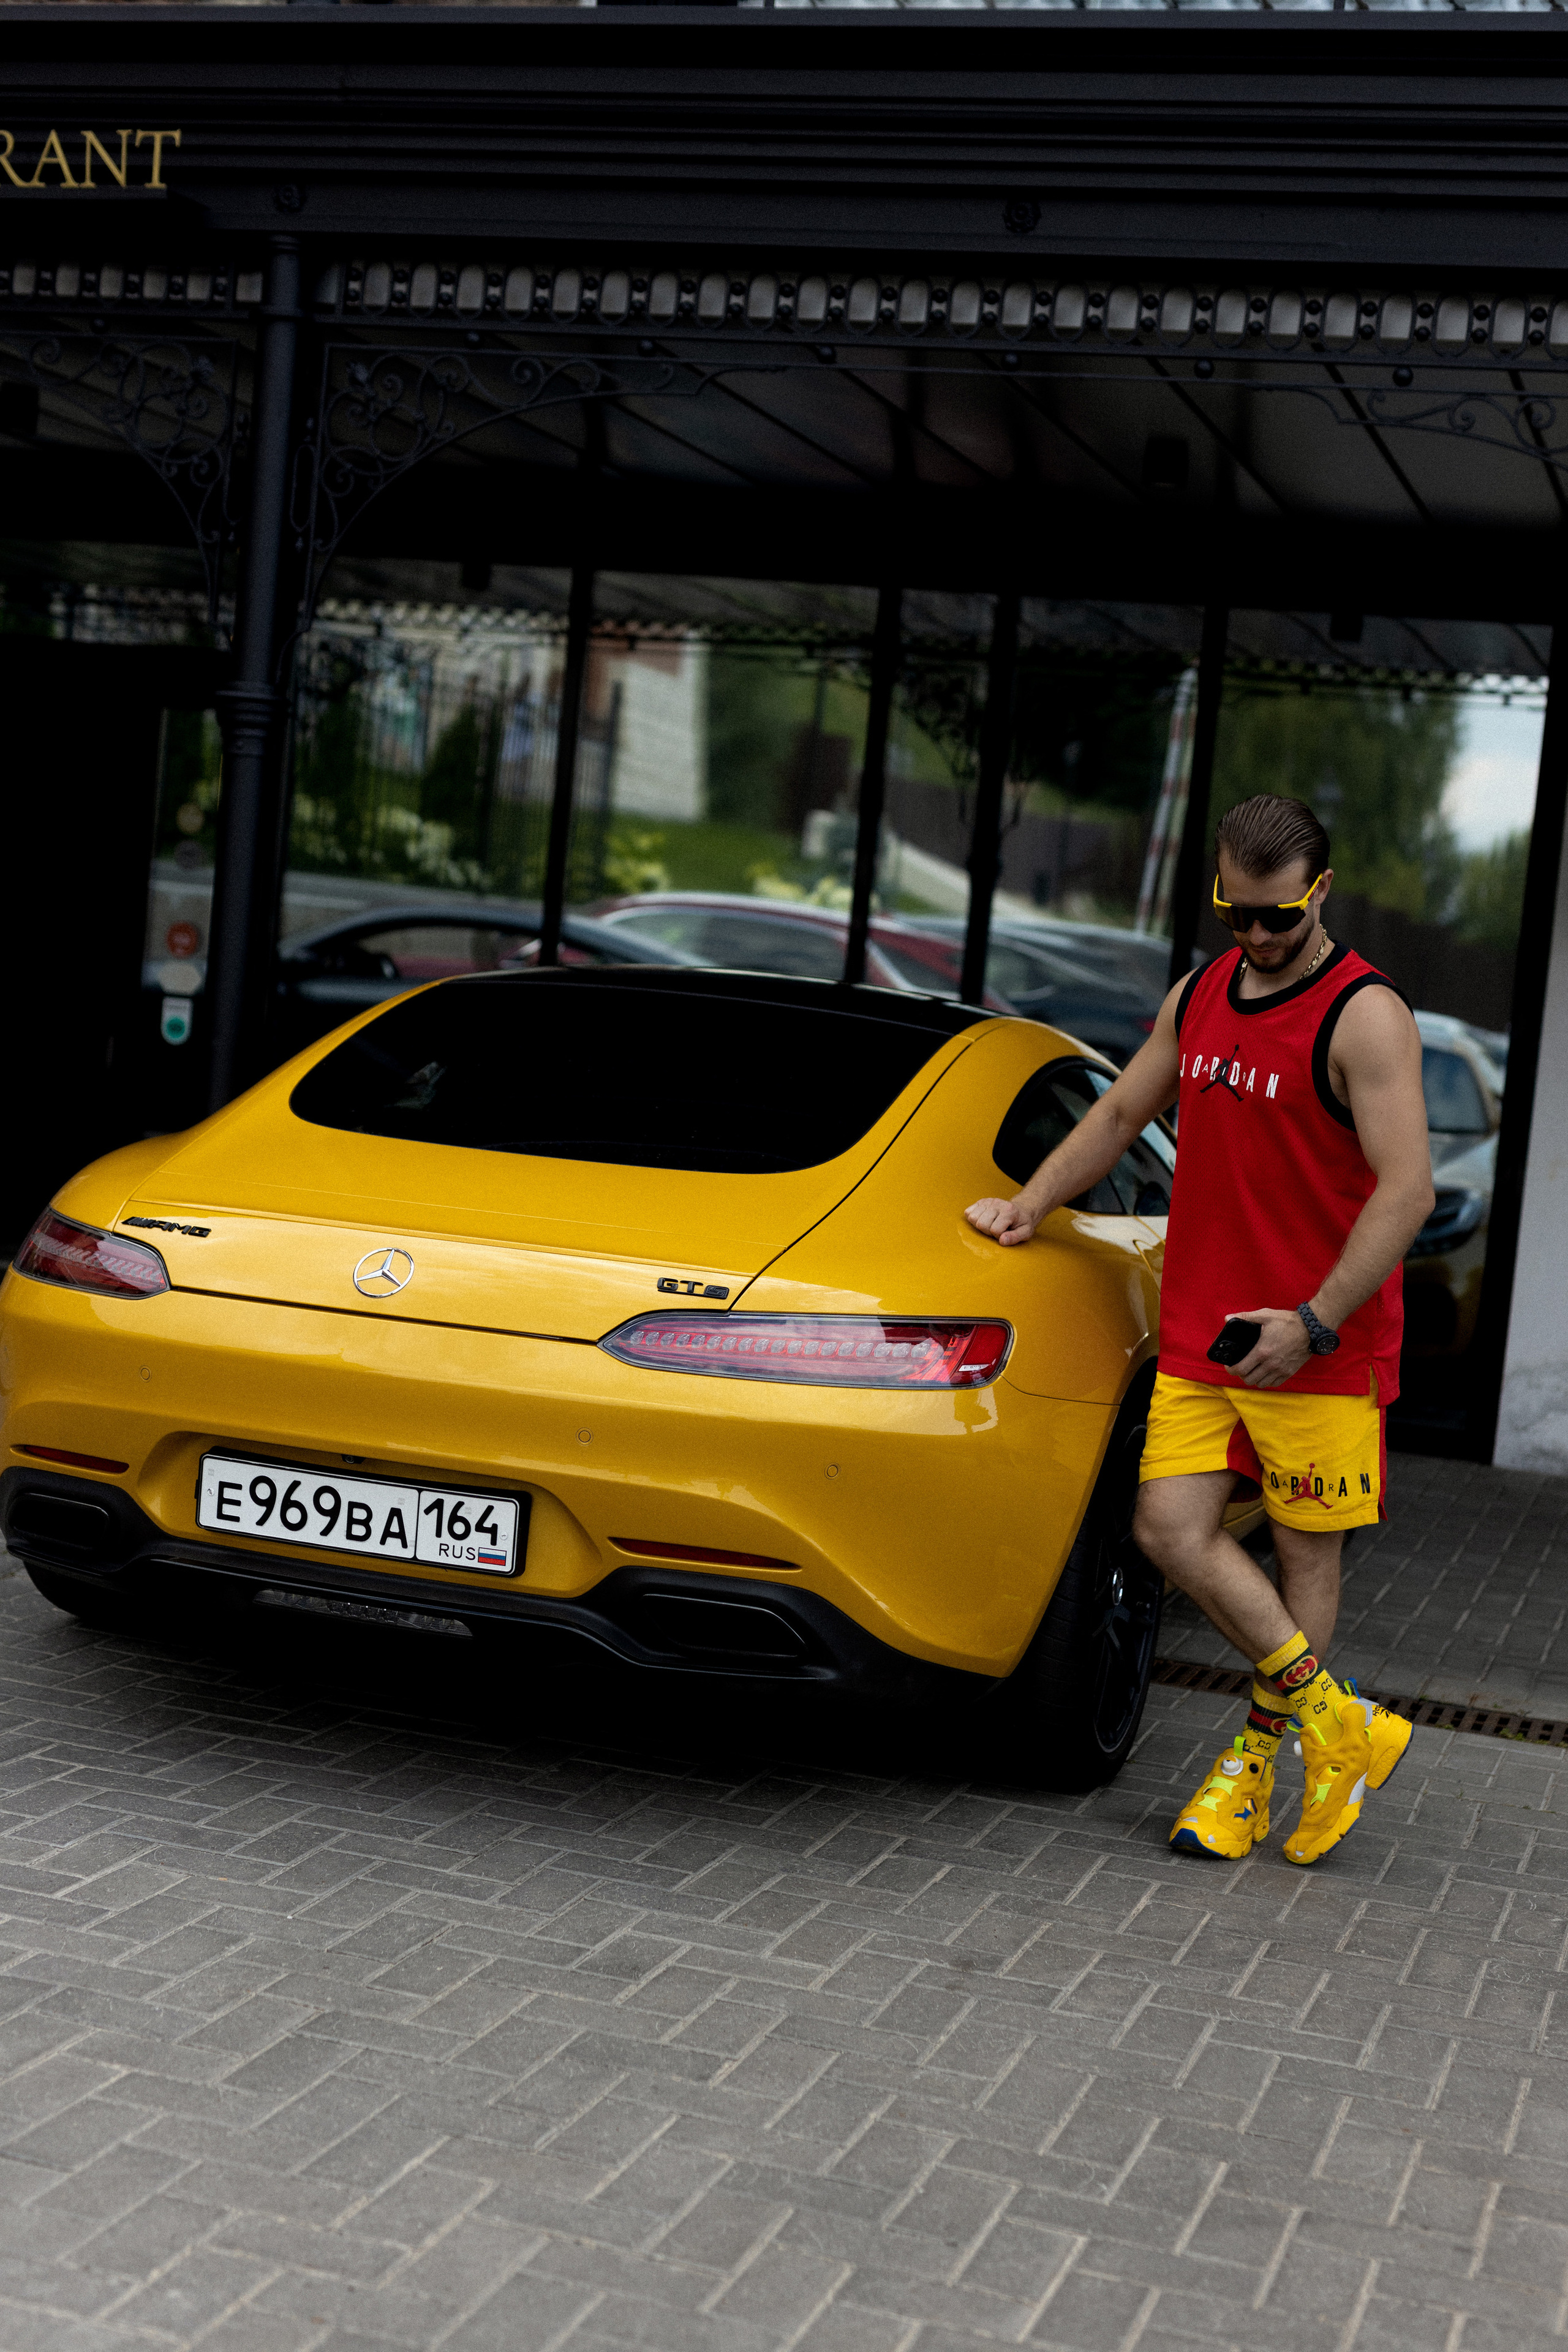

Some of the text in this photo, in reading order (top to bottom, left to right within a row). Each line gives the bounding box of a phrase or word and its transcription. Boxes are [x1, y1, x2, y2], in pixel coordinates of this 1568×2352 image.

[1180, 1053, 1280, 1099] JORDAN
[145, 1218, 212, 1238] AMG
[216, 1475, 499, 1549] E969BA 164
[439, 1543, 476, 1561] RUS
